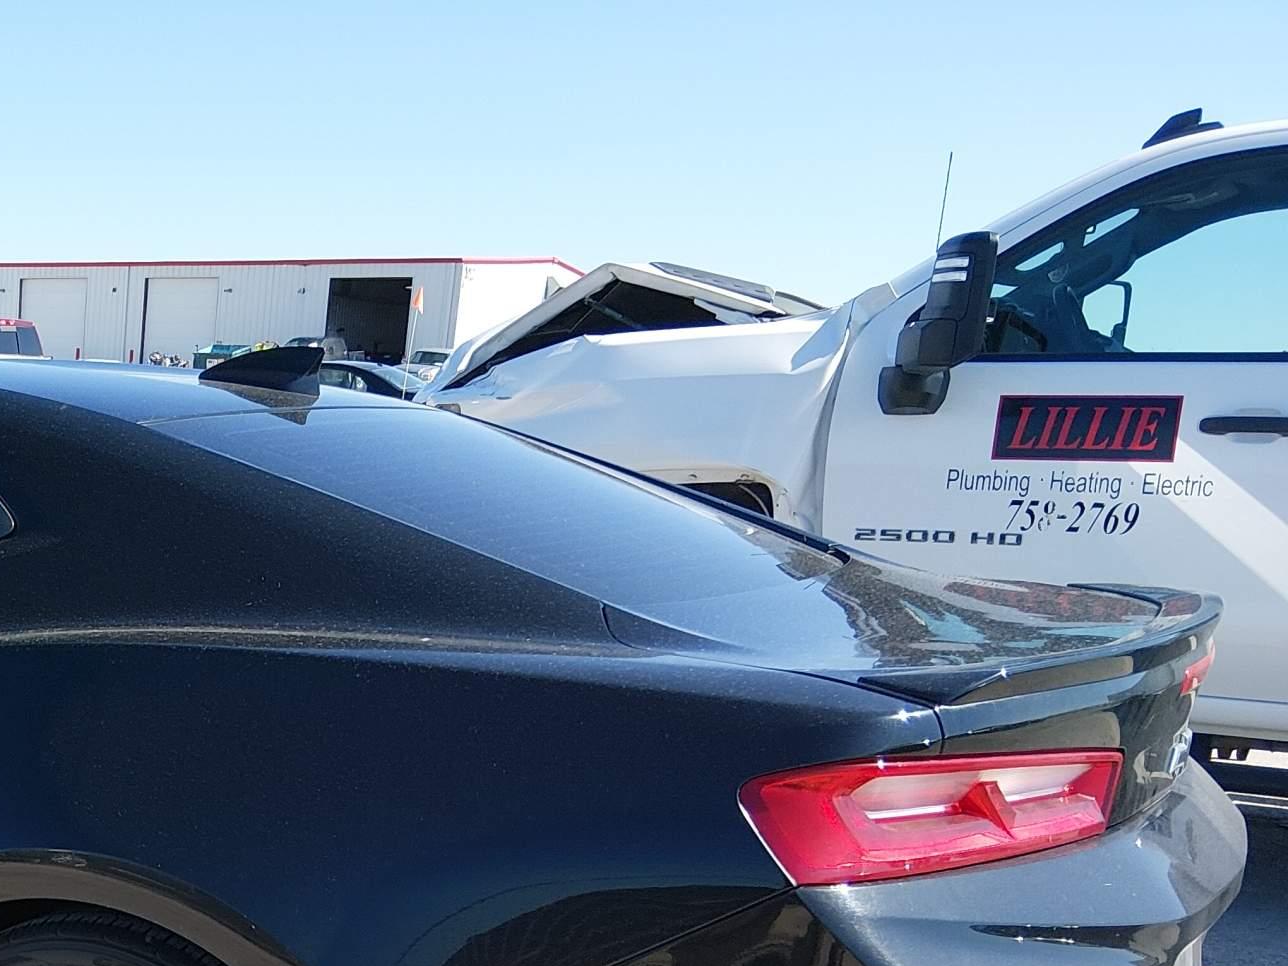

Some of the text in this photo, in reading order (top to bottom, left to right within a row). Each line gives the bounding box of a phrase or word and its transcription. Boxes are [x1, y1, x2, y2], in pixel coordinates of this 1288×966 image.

[1007, 406, 1166, 451] LILLIE
[945, 468, 1214, 500] Plumbing Heating Electric
[1006, 499, 1140, 535] 758-2769
[854, 527, 1023, 546] 2500 HD
